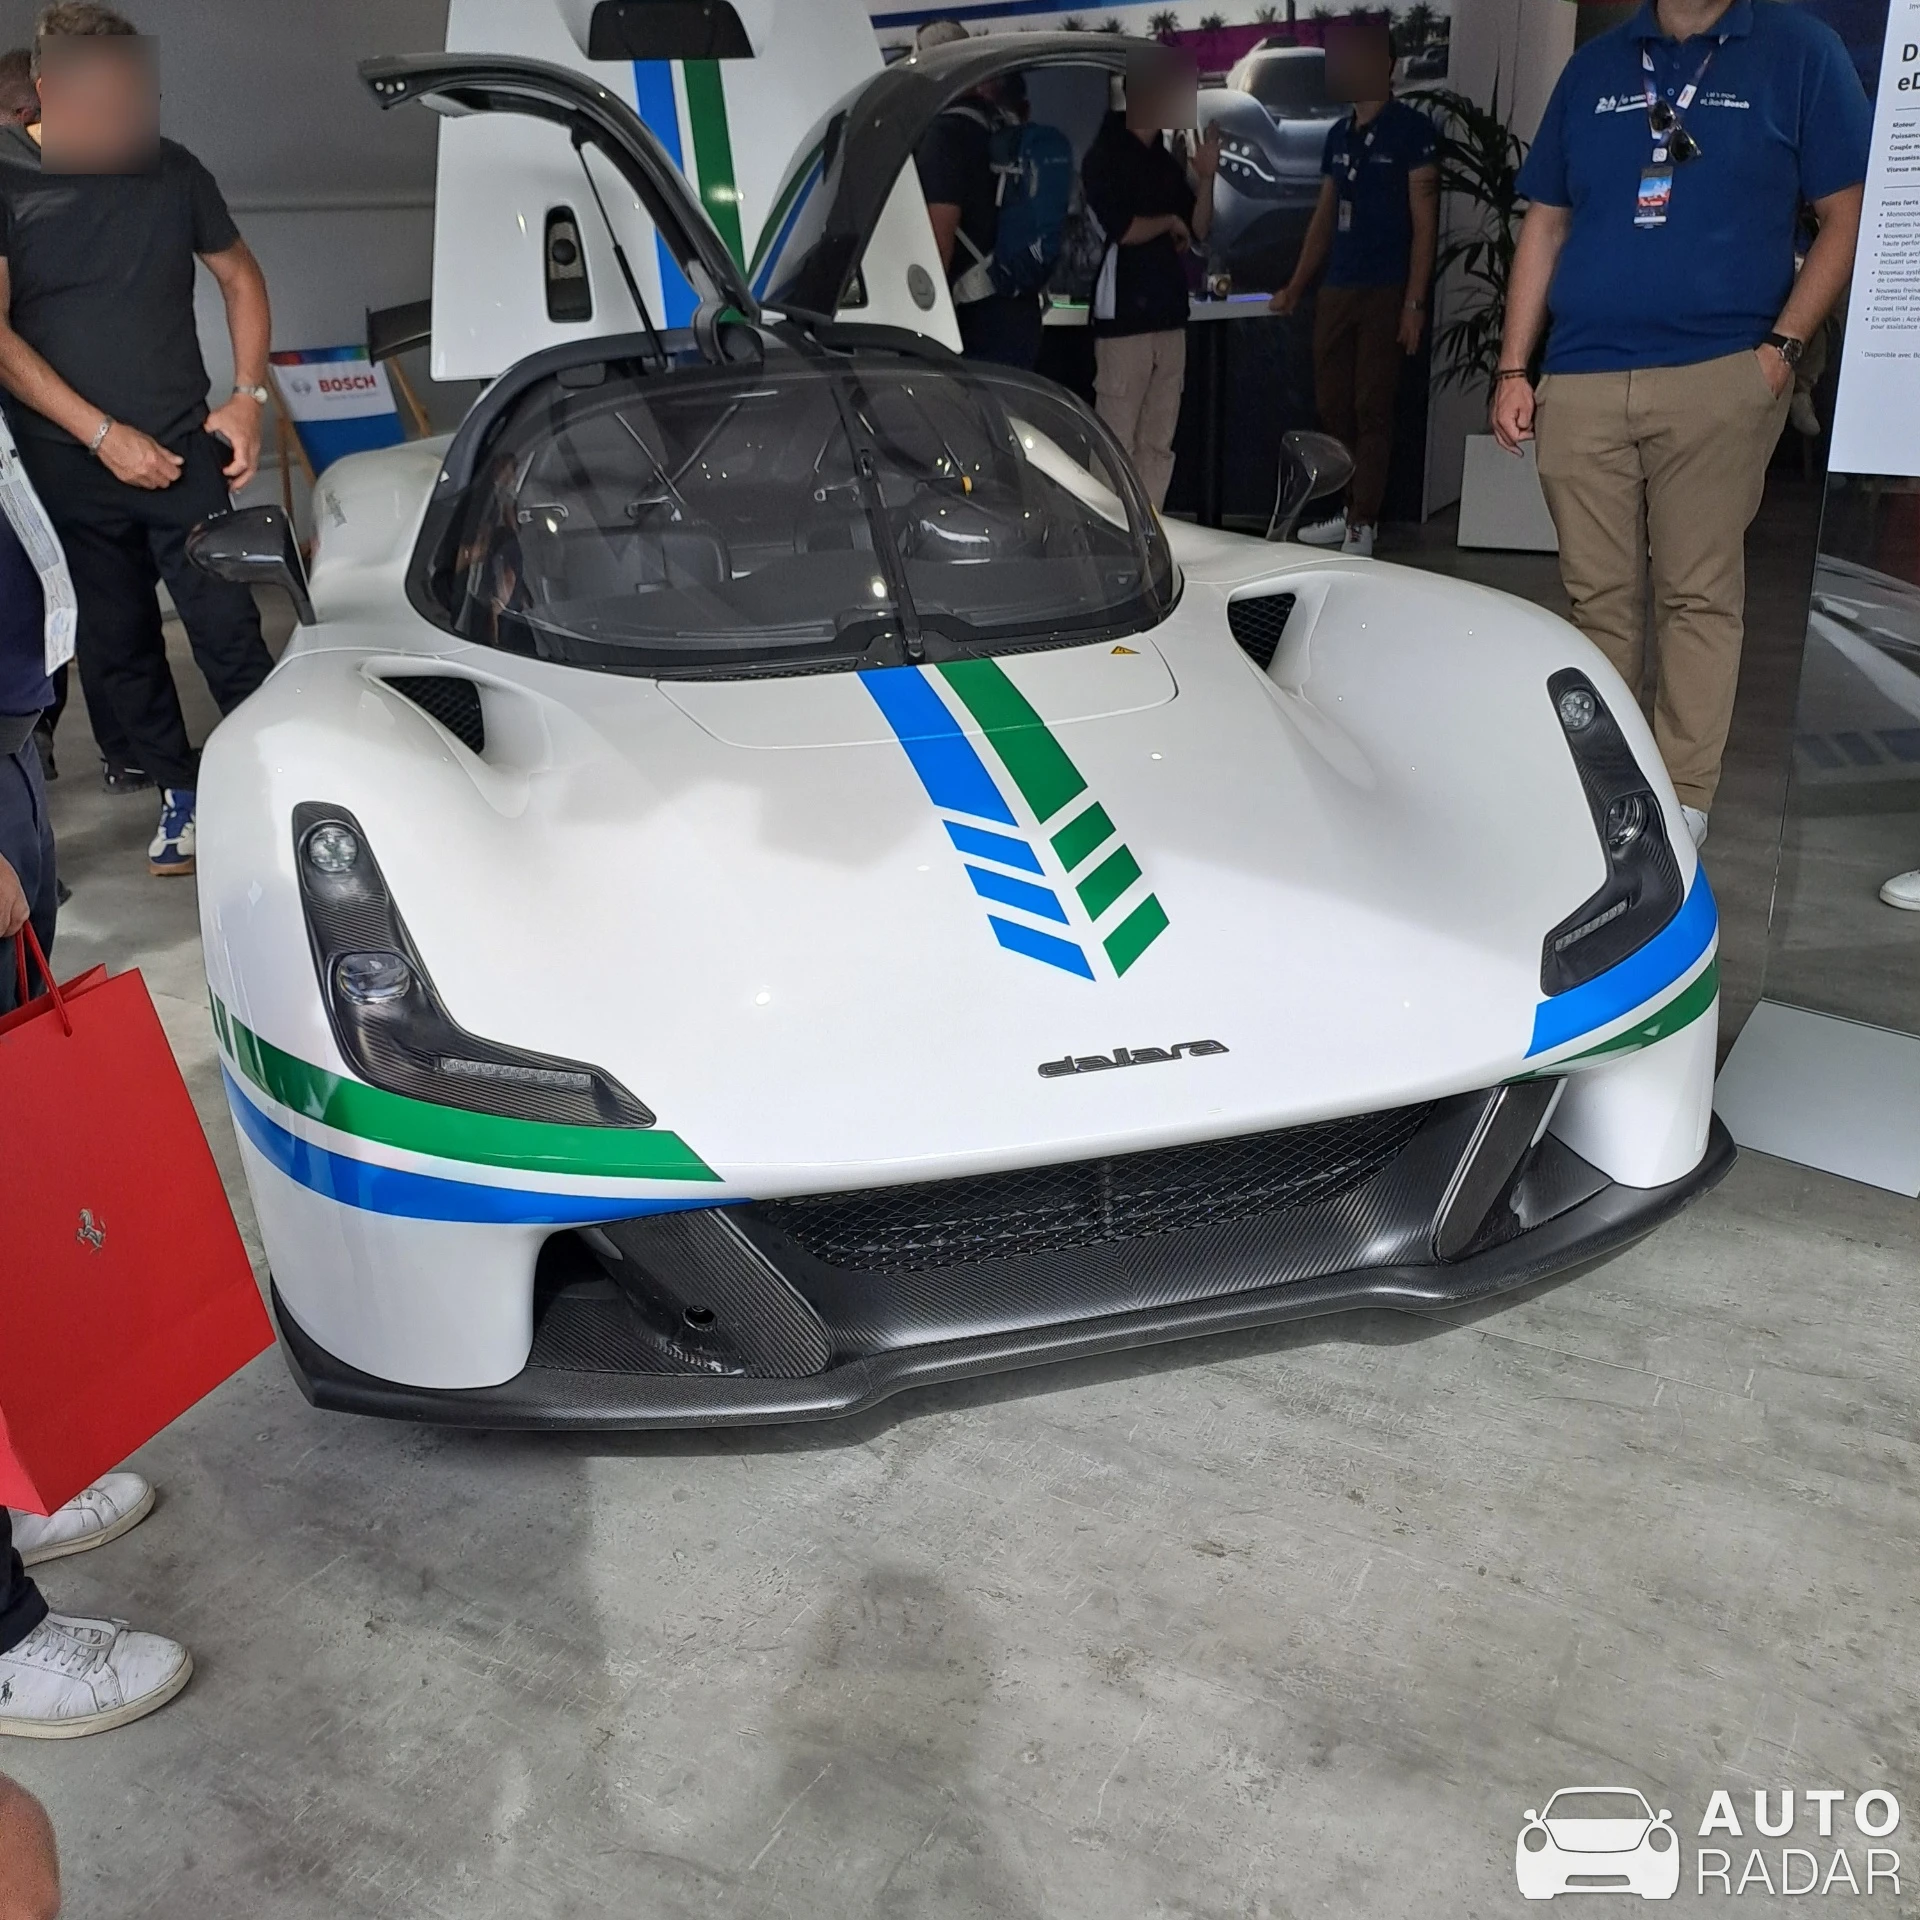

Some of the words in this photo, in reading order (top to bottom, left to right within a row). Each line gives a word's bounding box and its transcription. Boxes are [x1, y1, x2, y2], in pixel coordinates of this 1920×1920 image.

[1889, 143, 1912, 151] Couple
[319, 375, 376, 392] BOSCH
[1037, 1038, 1231, 1079] dallara
